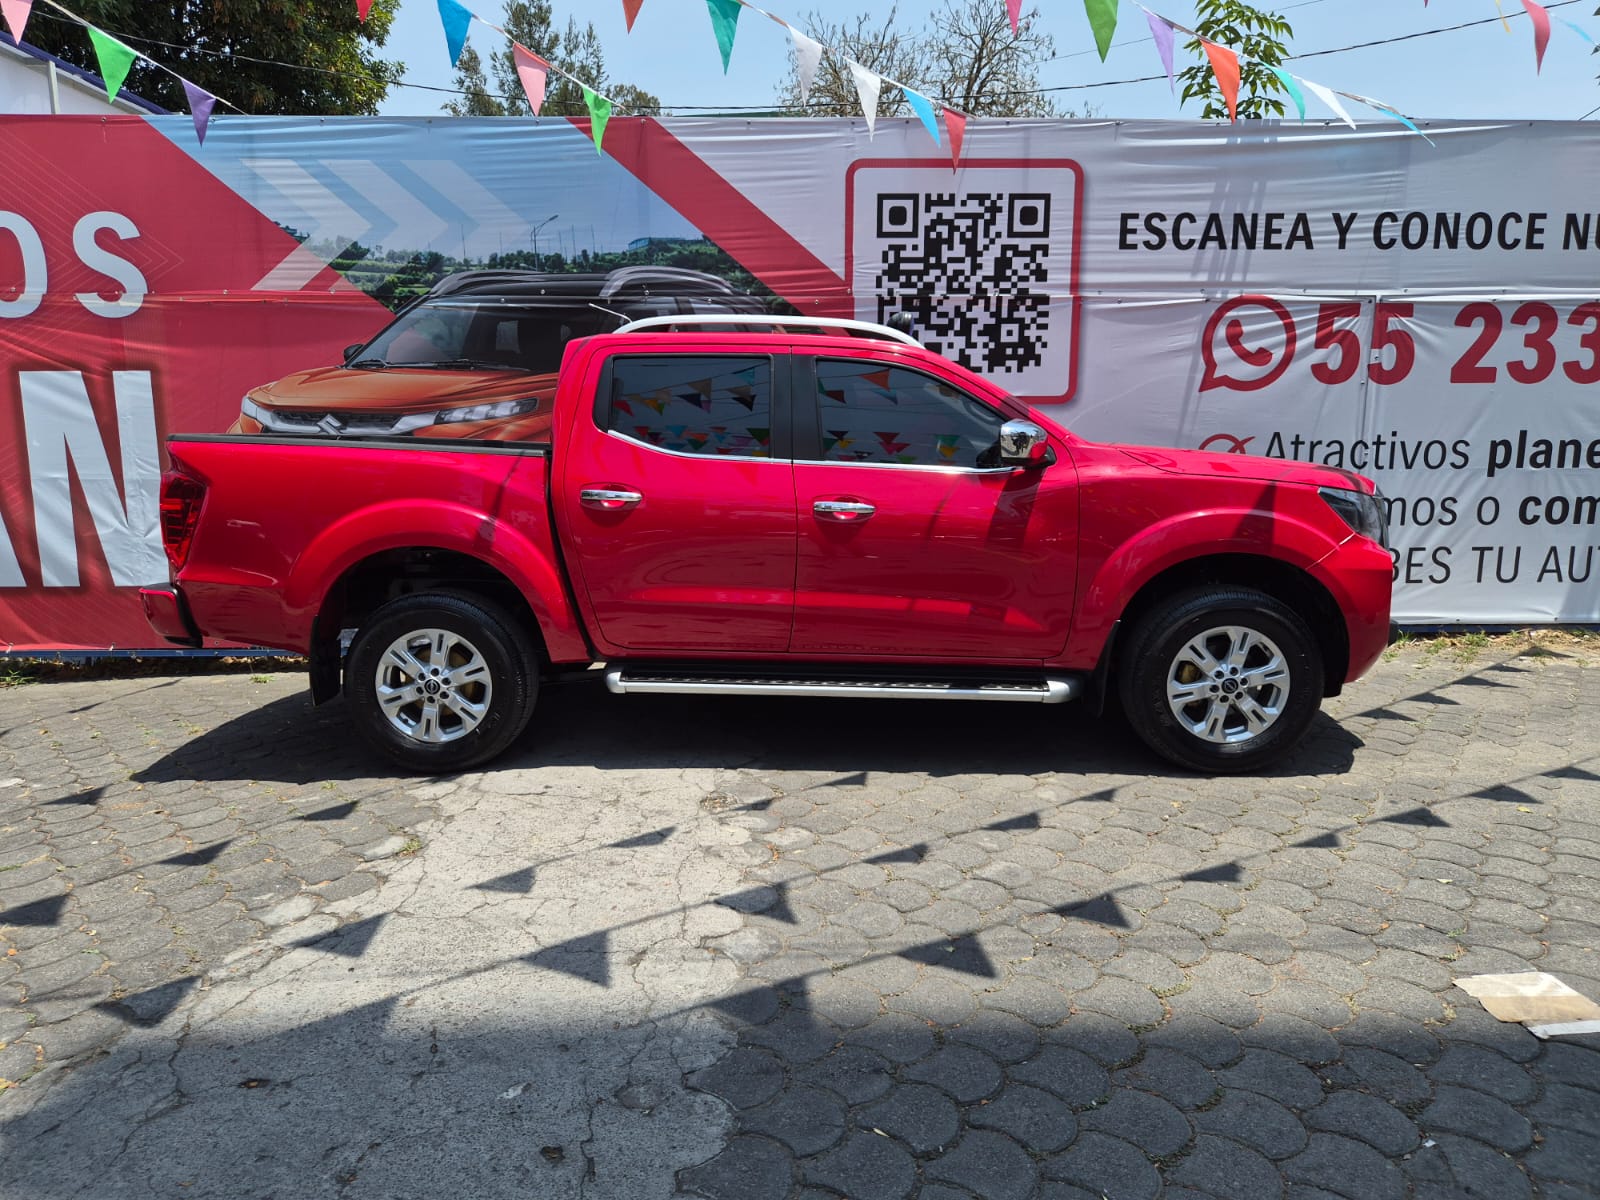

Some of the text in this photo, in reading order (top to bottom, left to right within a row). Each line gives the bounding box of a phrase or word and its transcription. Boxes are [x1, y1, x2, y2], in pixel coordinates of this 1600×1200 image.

[1118, 211, 1600, 251] ESCANEA Y CONOCE N
[1310, 301, 1600, 386] 55 233
[1265, 430, 1471, 470] Atractivos
[0, 370, 170, 588] N
[1476, 496, 1500, 526] o
[1471, 546, 1522, 584] TU
[1536, 546, 1600, 584] AU
